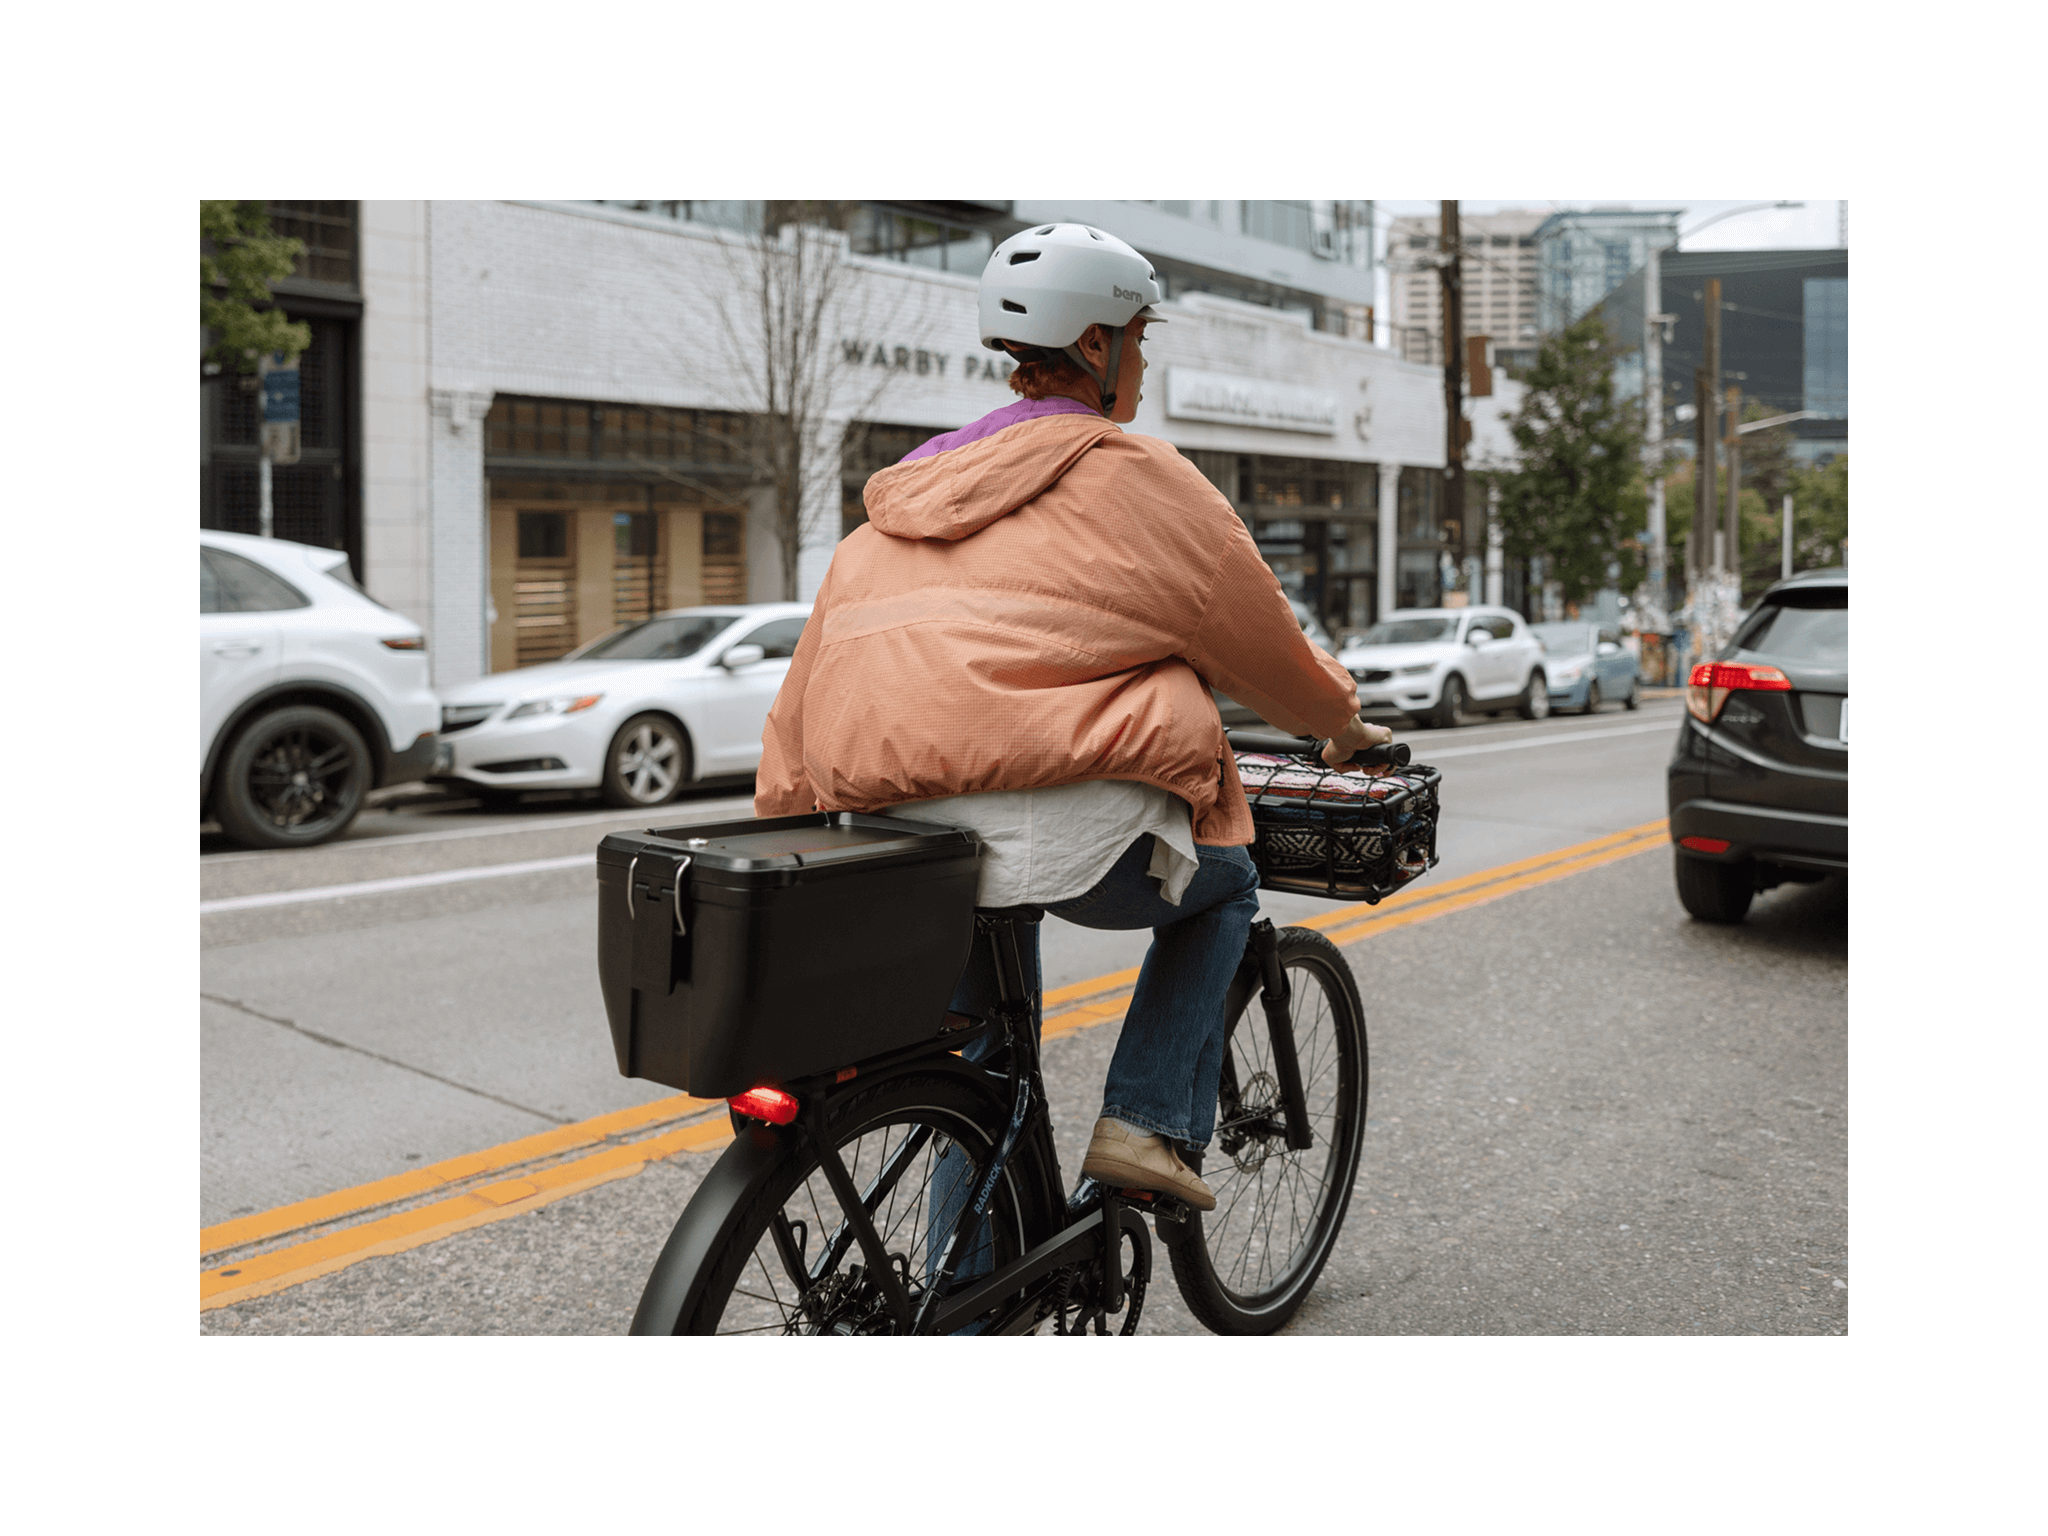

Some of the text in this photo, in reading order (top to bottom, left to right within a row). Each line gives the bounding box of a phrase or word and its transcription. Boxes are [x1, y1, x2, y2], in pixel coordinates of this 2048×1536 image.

[1113, 285, 1142, 304] bern
[841, 339, 949, 376] WARBY
[973, 1162, 1001, 1214] RADKICK
